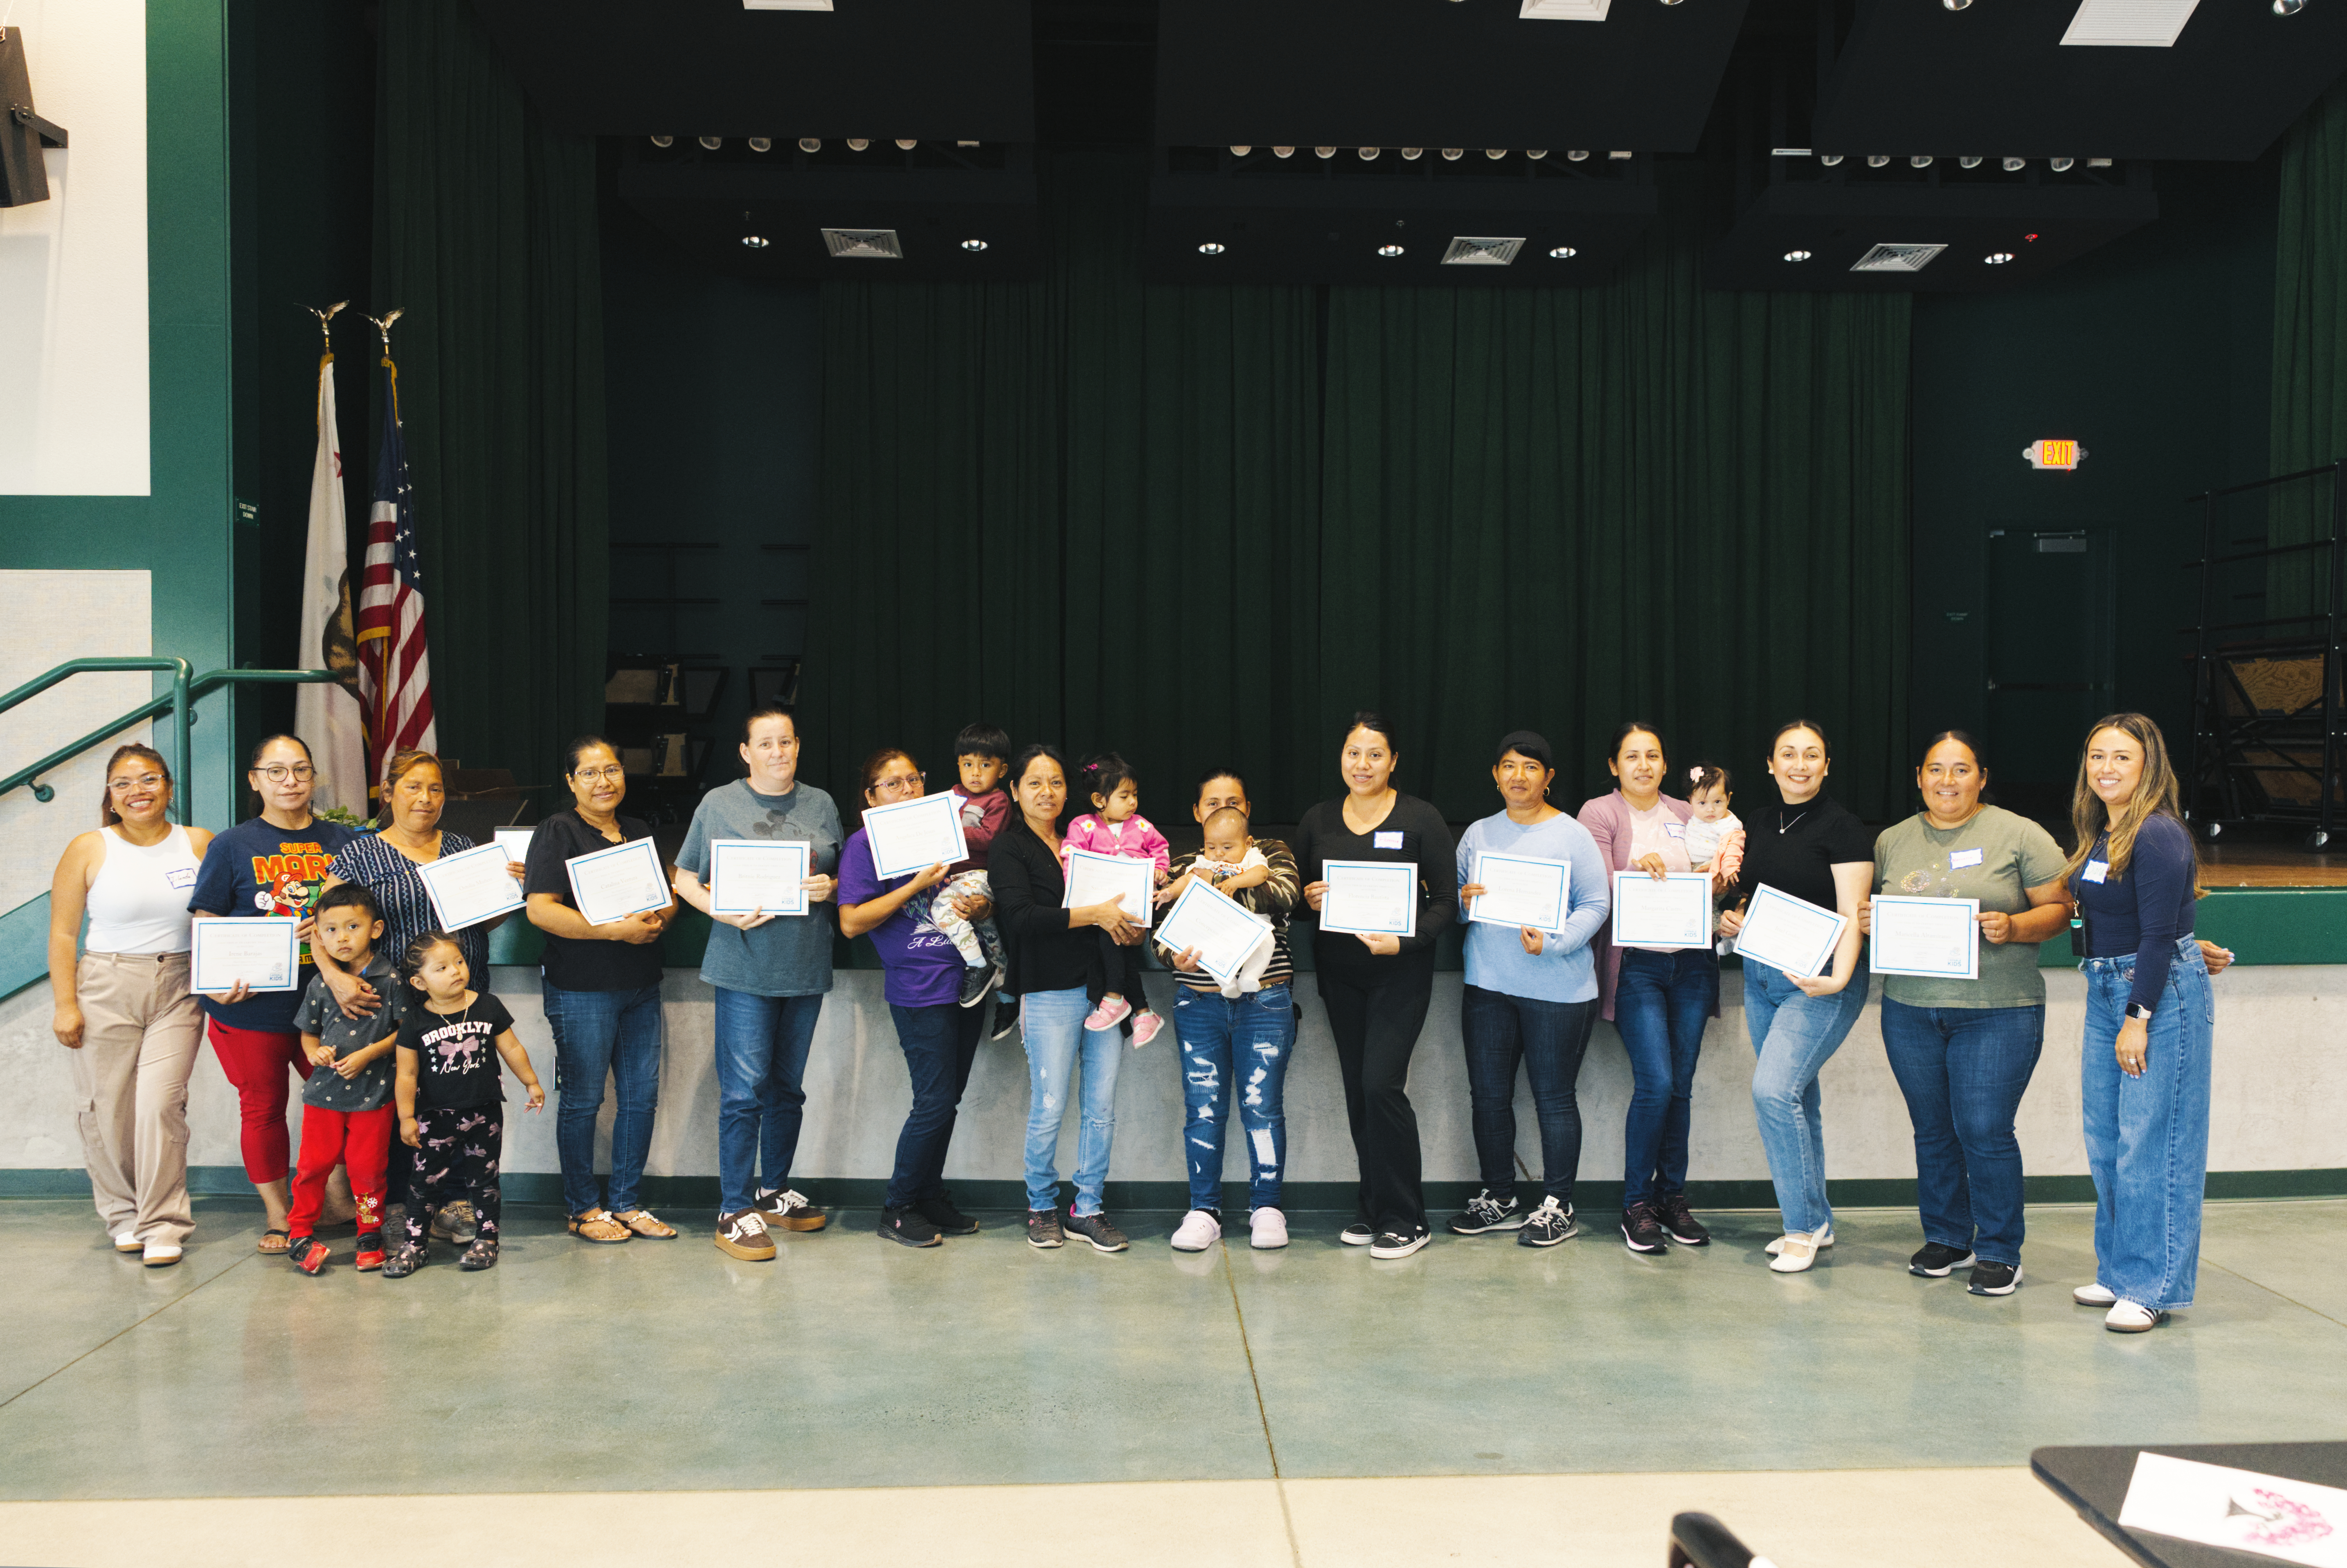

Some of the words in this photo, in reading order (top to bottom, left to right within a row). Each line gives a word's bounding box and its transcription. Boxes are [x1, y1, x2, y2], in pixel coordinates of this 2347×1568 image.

[2043, 441, 2074, 465] EXIT
[243, 511, 254, 519] DOWN
[279, 842, 323, 854] SUPER
[252, 854, 339, 885] MAR
[2086, 863, 2105, 876] Diana
[907, 937, 927, 949] A
[1215, 959, 1225, 968] KIDS
[421, 1021, 493, 1047] BROOKLYN
[439, 1060, 460, 1075] New
[462, 1058, 480, 1075] York
